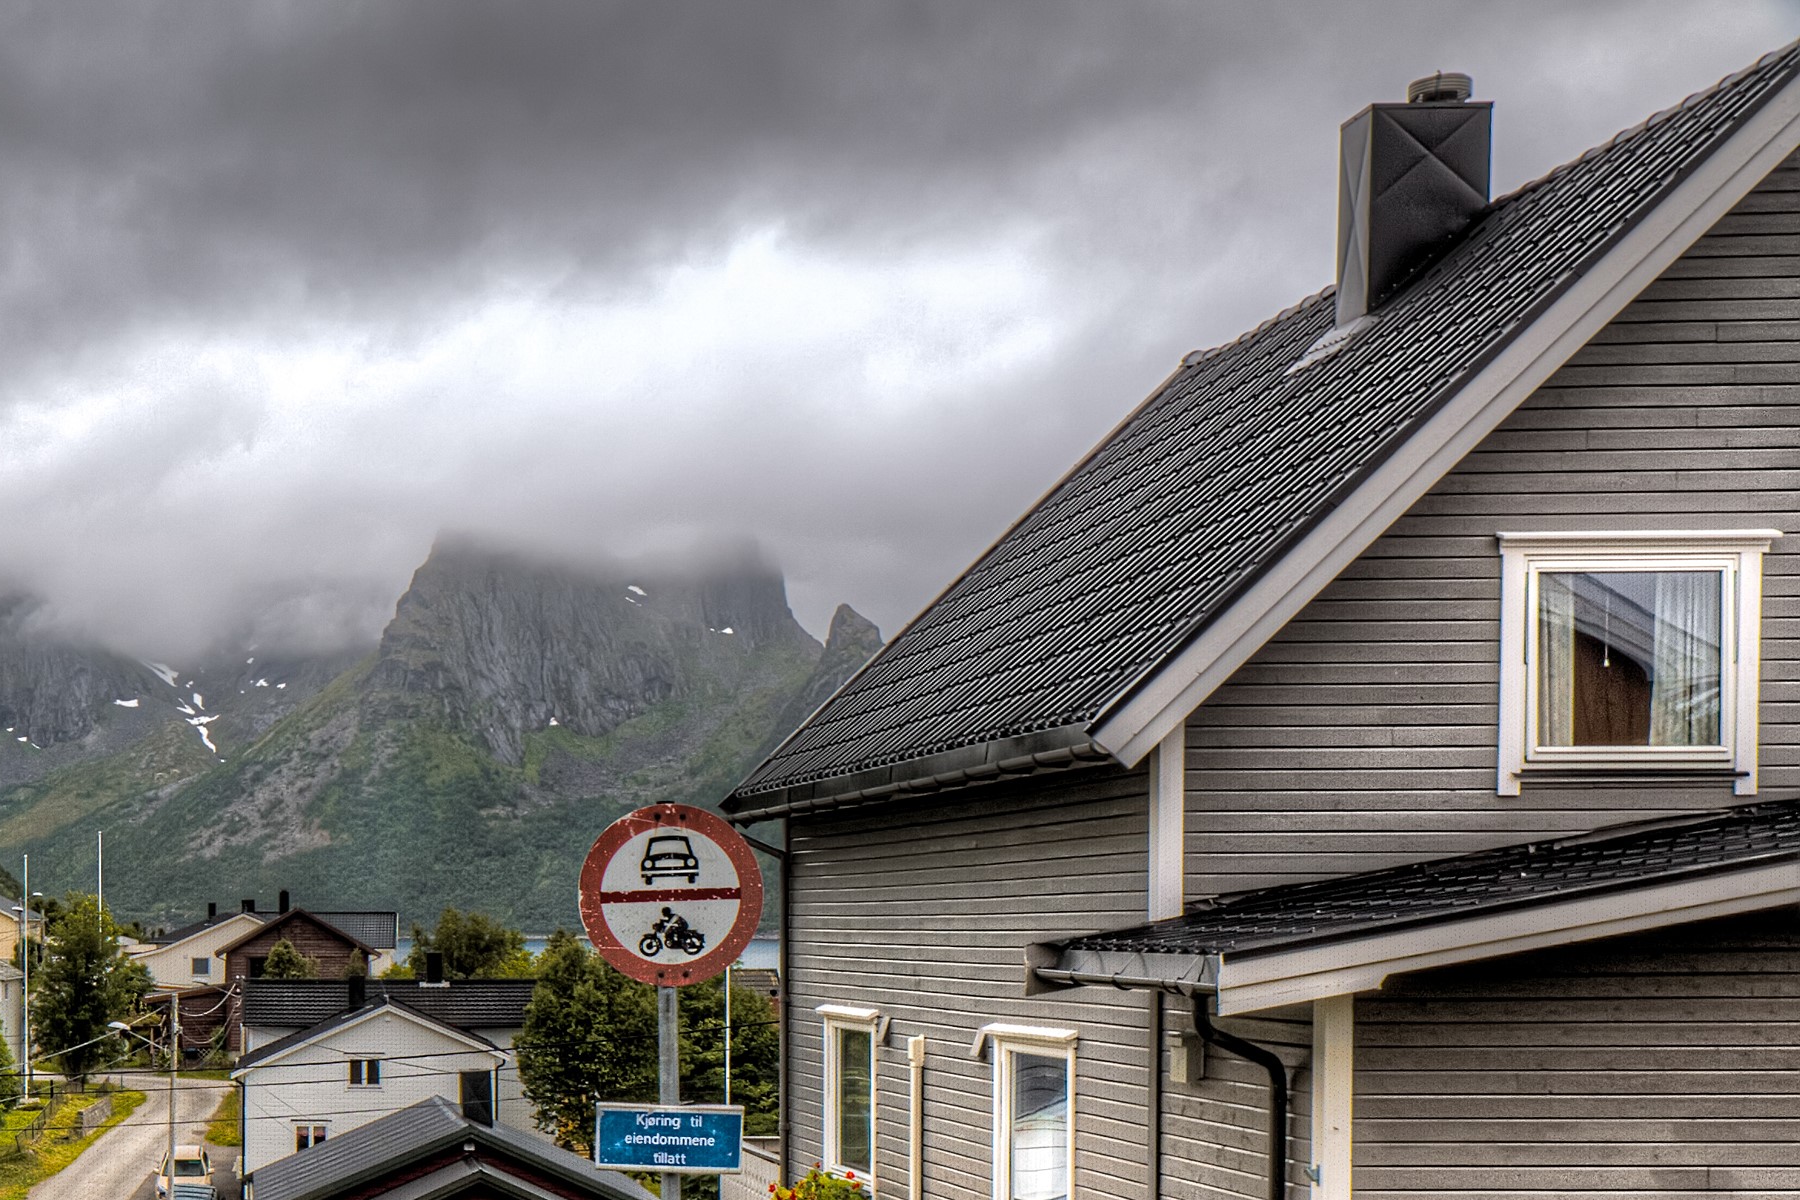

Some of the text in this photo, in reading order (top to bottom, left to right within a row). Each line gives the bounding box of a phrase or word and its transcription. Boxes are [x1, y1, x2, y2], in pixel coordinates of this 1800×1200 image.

[636, 1113, 703, 1129] Kjøring til
[625, 1133, 715, 1146] eiendommene
[653, 1152, 687, 1164] tillatt
